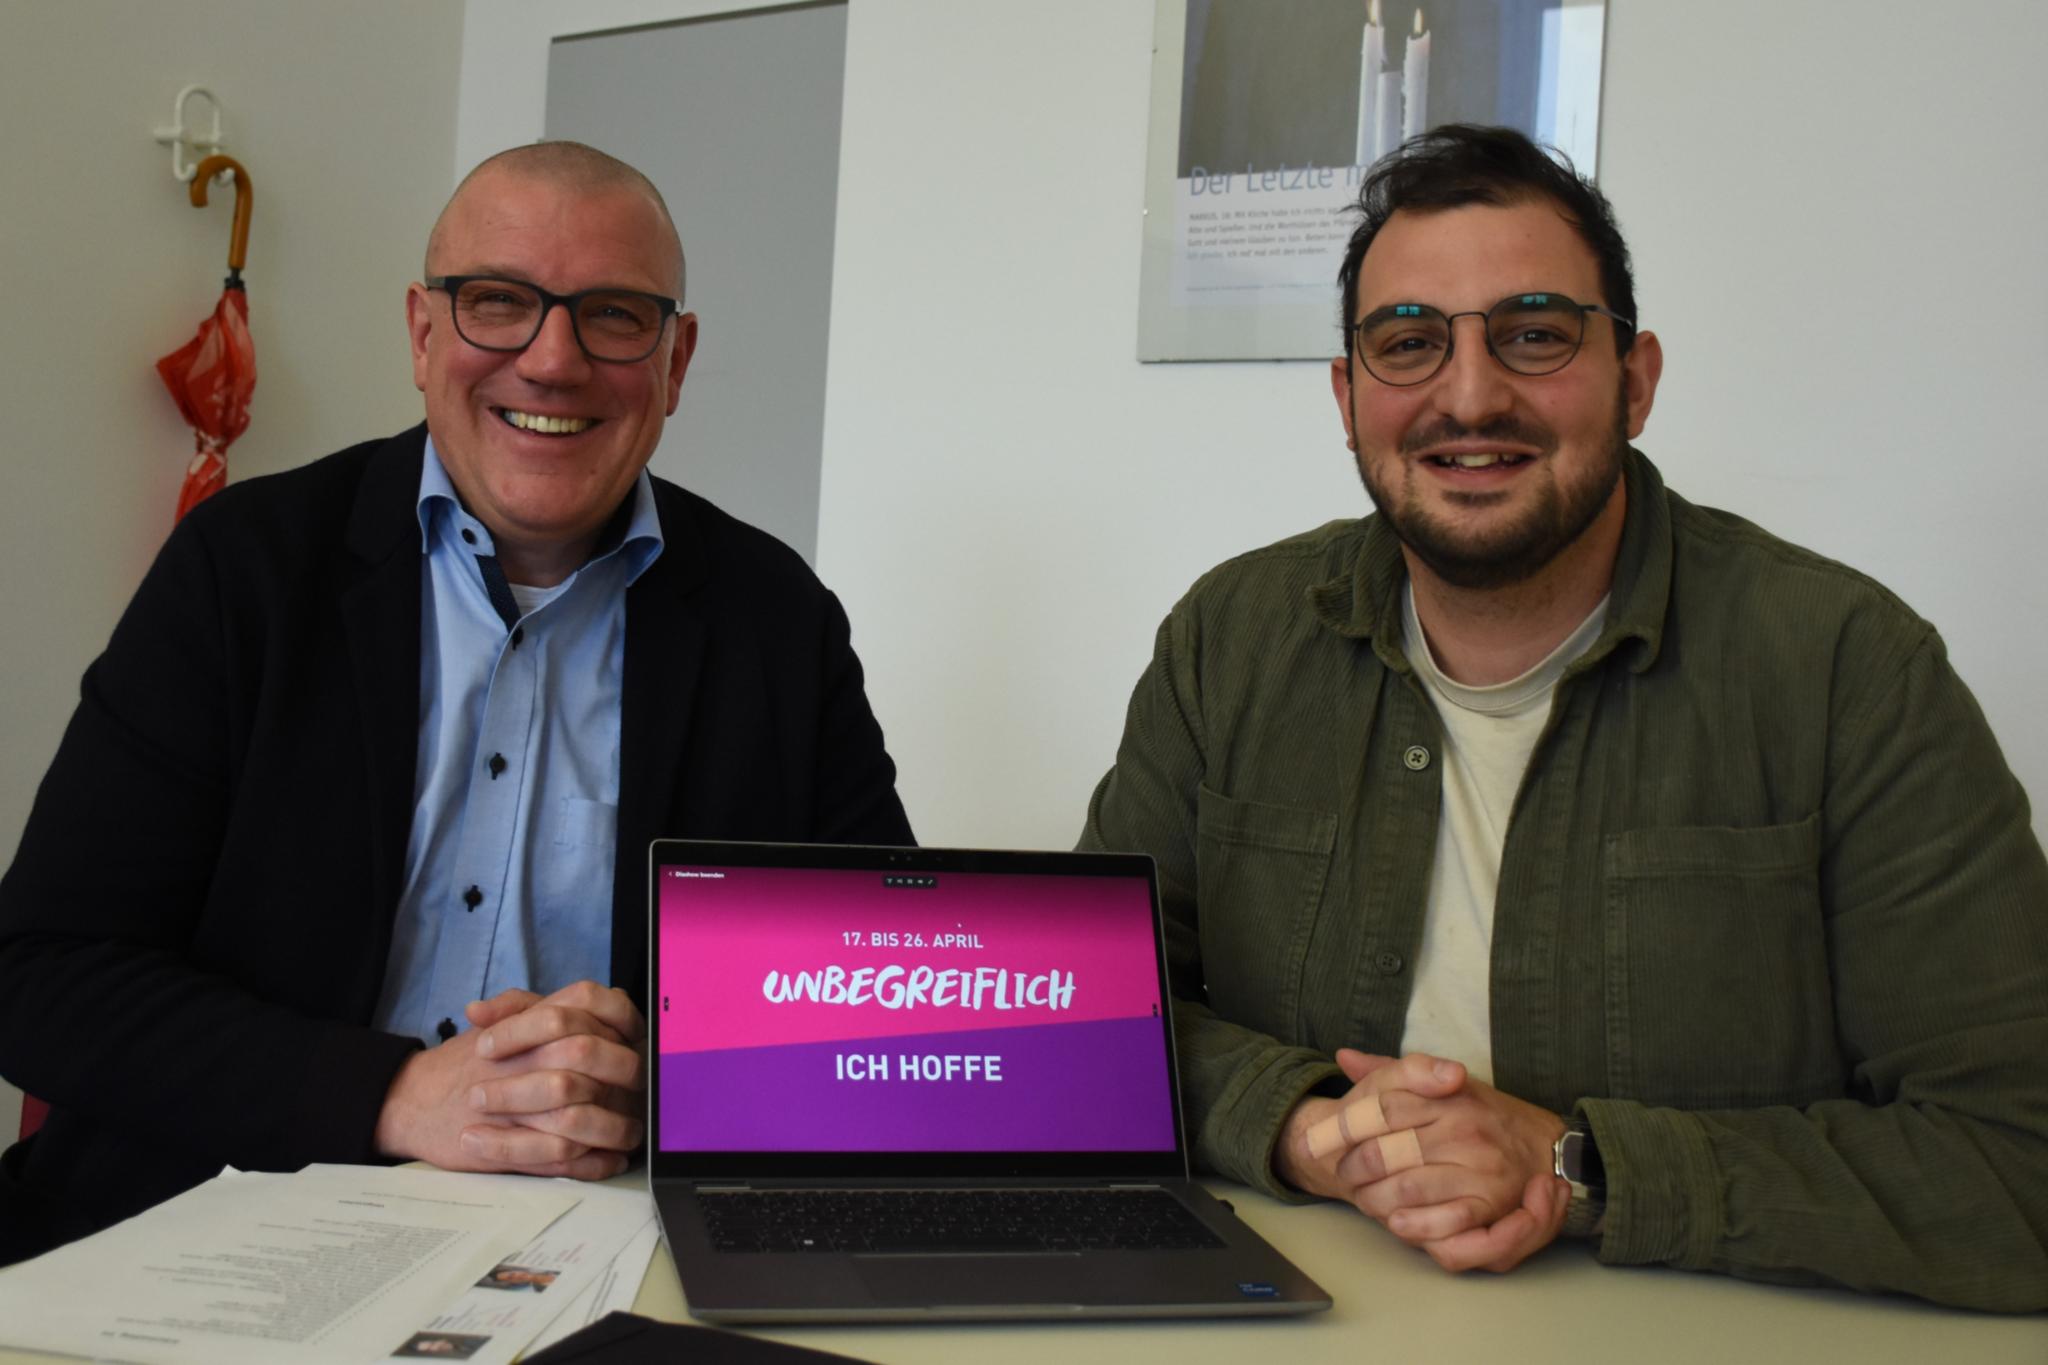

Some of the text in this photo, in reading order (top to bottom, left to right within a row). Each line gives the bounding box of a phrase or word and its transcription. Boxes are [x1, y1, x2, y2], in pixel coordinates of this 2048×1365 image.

[1190, 165, 1234, 196] Der
[1246, 161, 1334, 193] Letzte
[842, 931, 984, 949] 17. BIS 26. APRIL
[762, 964, 1077, 1011] UNBEGREIFLICH
[836, 1053, 1003, 1081] ICH HOFFE
